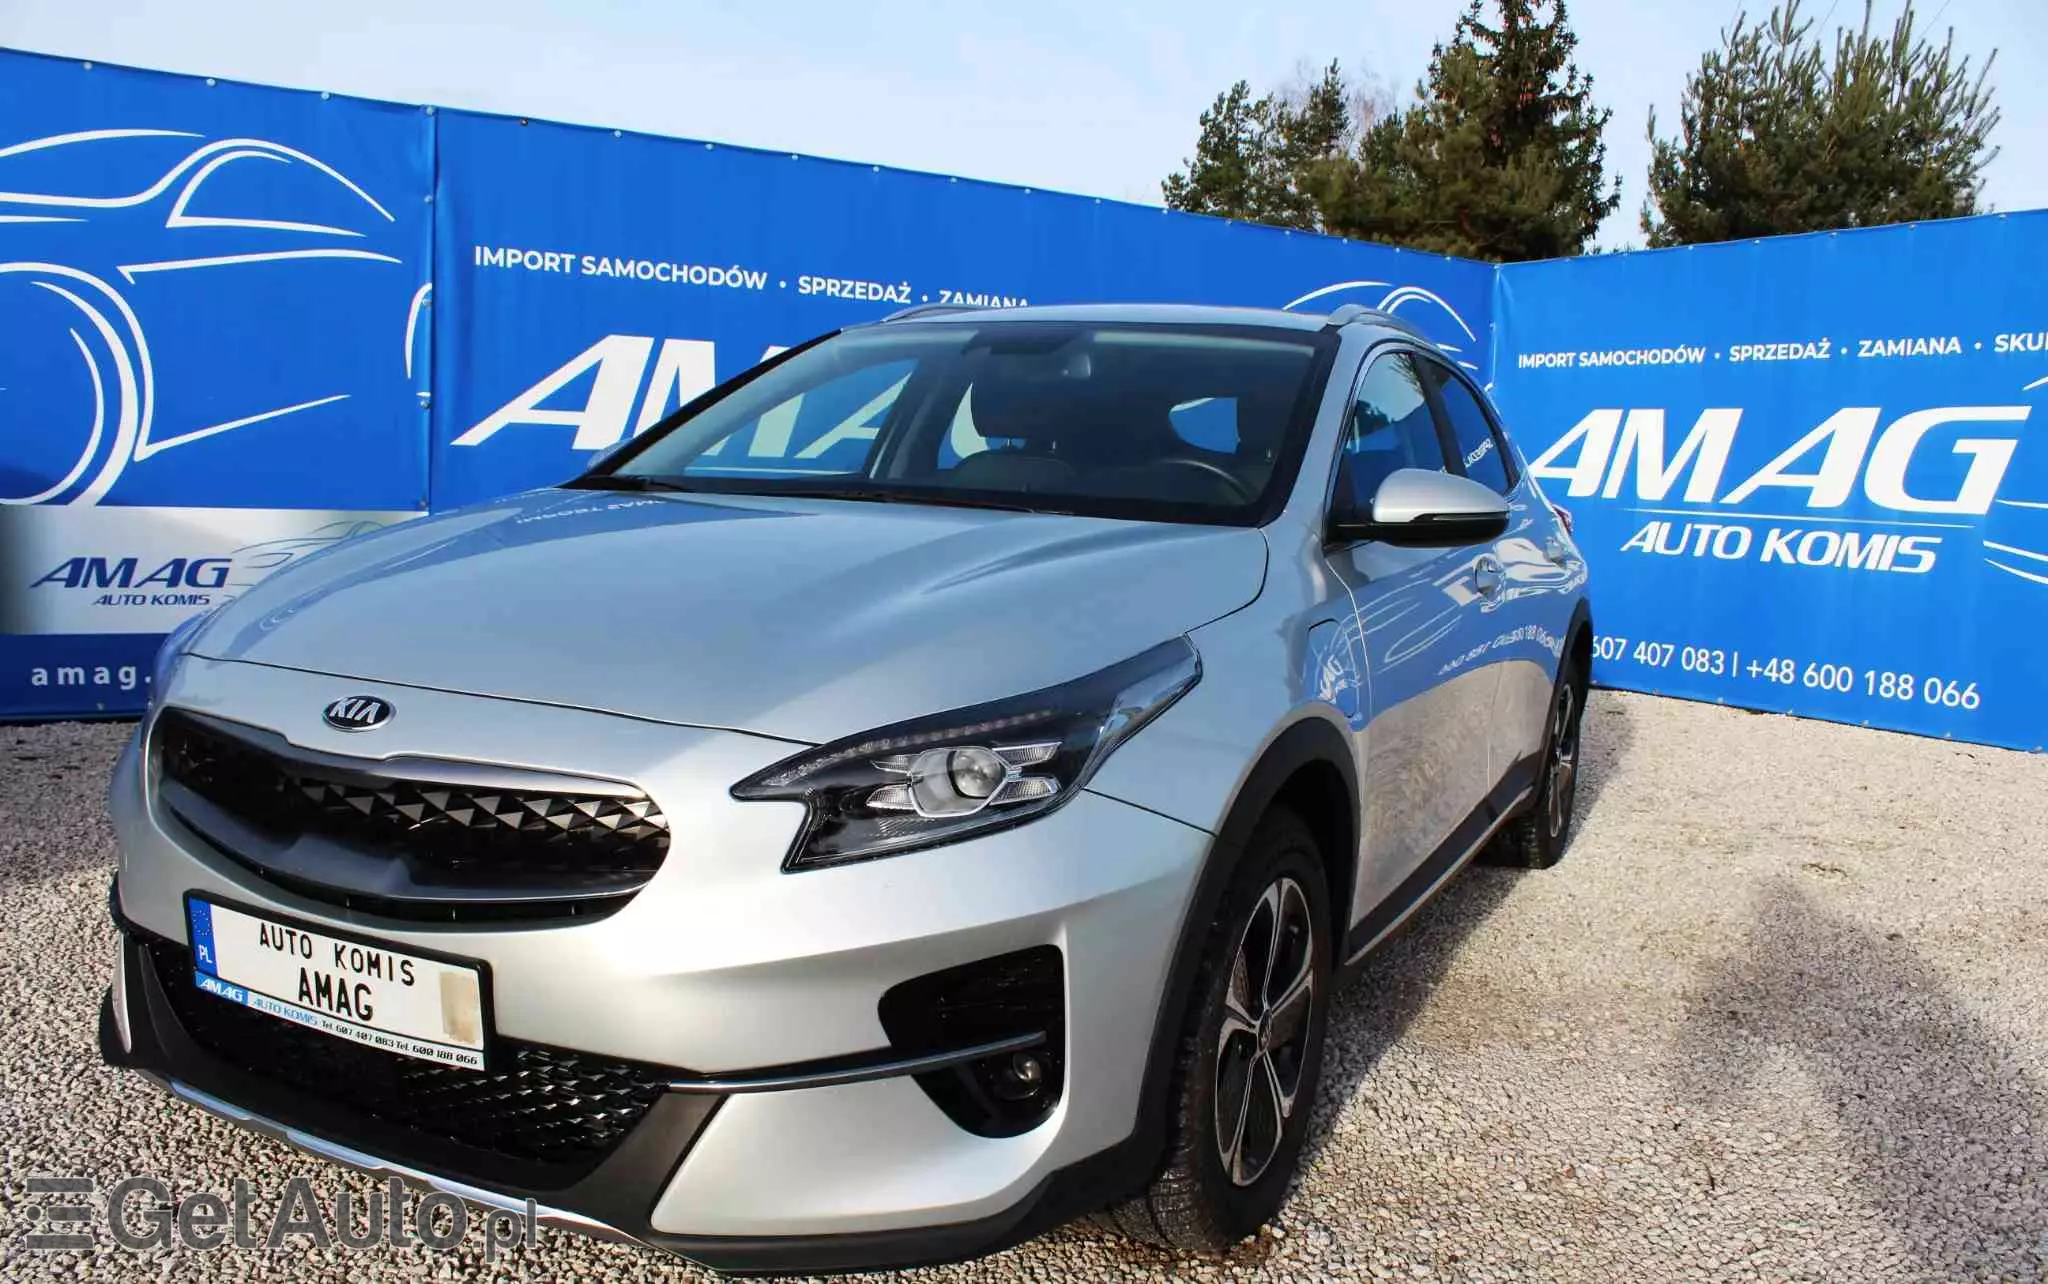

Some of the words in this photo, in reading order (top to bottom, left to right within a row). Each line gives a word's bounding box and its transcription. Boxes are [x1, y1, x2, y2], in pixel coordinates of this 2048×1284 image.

[474, 246, 575, 273] IMPORT
[581, 256, 768, 290] SAMOCHODÓW
[798, 275, 912, 304] SPRZEDAŻ
[1518, 353, 1575, 369] IMPORT
[1579, 346, 1706, 367] SAMOCHODÓW
[1729, 337, 1832, 362] SPRZEDAŻ
[1858, 336, 1962, 358] ZAMIANA
[1994, 332, 2048, 353] SKU
[30, 557, 232, 589] AMAG
[1620, 520, 1750, 560] AUTO
[1759, 528, 1943, 574] KOMIS
[94, 594, 147, 606] AUTO
[151, 594, 211, 606] KOMIS
[1633, 641, 1675, 667] 407
[1681, 646, 1725, 675] 083
[1746, 657, 1795, 684] +48
[1803, 663, 1852, 692] 600
[1866, 670, 1913, 701] 188
[1925, 677, 1981, 710] 066
[328, 696, 382, 724] KIA
[199, 944, 213, 964] PL
[259, 922, 313, 959] AUTO
[335, 943, 415, 986] KOMIS
[298, 967, 373, 1021] AMAG
[254, 998, 281, 1014] AUTO
[283, 1008, 318, 1026] KOMIS
[336, 1025, 353, 1035] 607
[413, 1045, 433, 1056] 600
[436, 1049, 453, 1061] 188
[456, 1054, 477, 1065] 066
